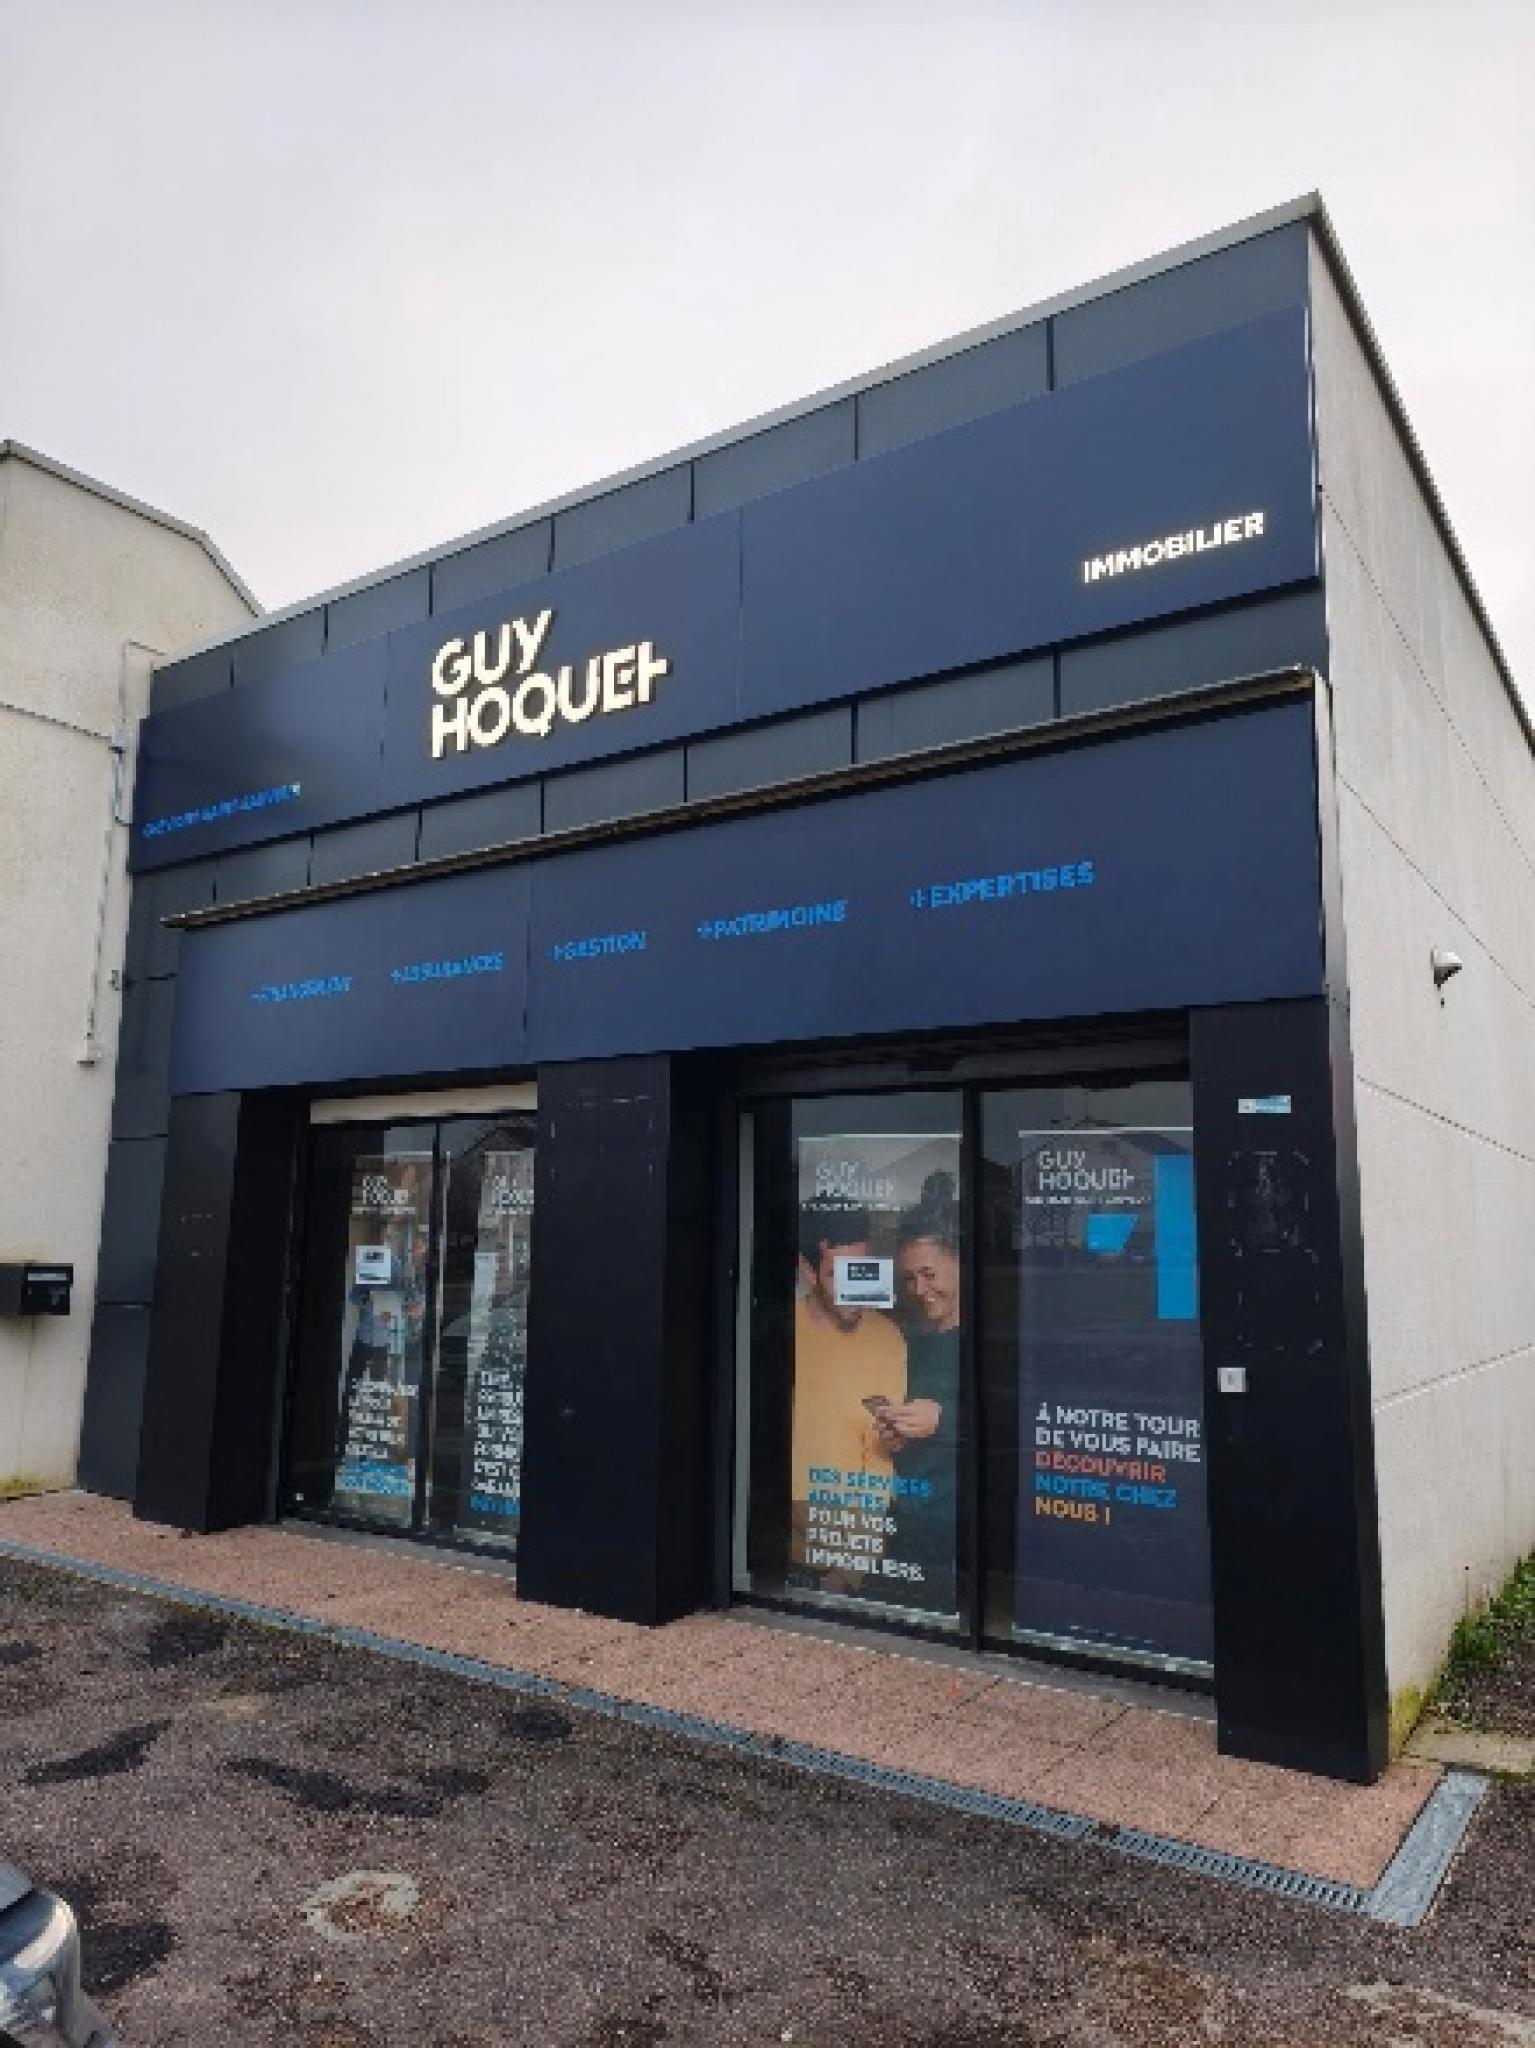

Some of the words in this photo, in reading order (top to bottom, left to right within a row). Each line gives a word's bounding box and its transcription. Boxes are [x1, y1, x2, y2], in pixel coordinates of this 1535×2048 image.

[1084, 512, 1264, 584] IMMOBILIER
[432, 609, 553, 697] GUY
[1038, 1150, 1087, 1171] GUY
[1056, 1405, 1129, 1432] NOTRE
[1134, 1413, 1201, 1438] TOUR
[1035, 1427, 1064, 1448] DE
[1069, 1431, 1131, 1455] VOUS
[1136, 1437, 1202, 1463] FAIRE
[1035, 1473, 1109, 1501] NOTRE
[1116, 1483, 1177, 1509] CHEZ
[1035, 1497, 1099, 1523] NOUS
